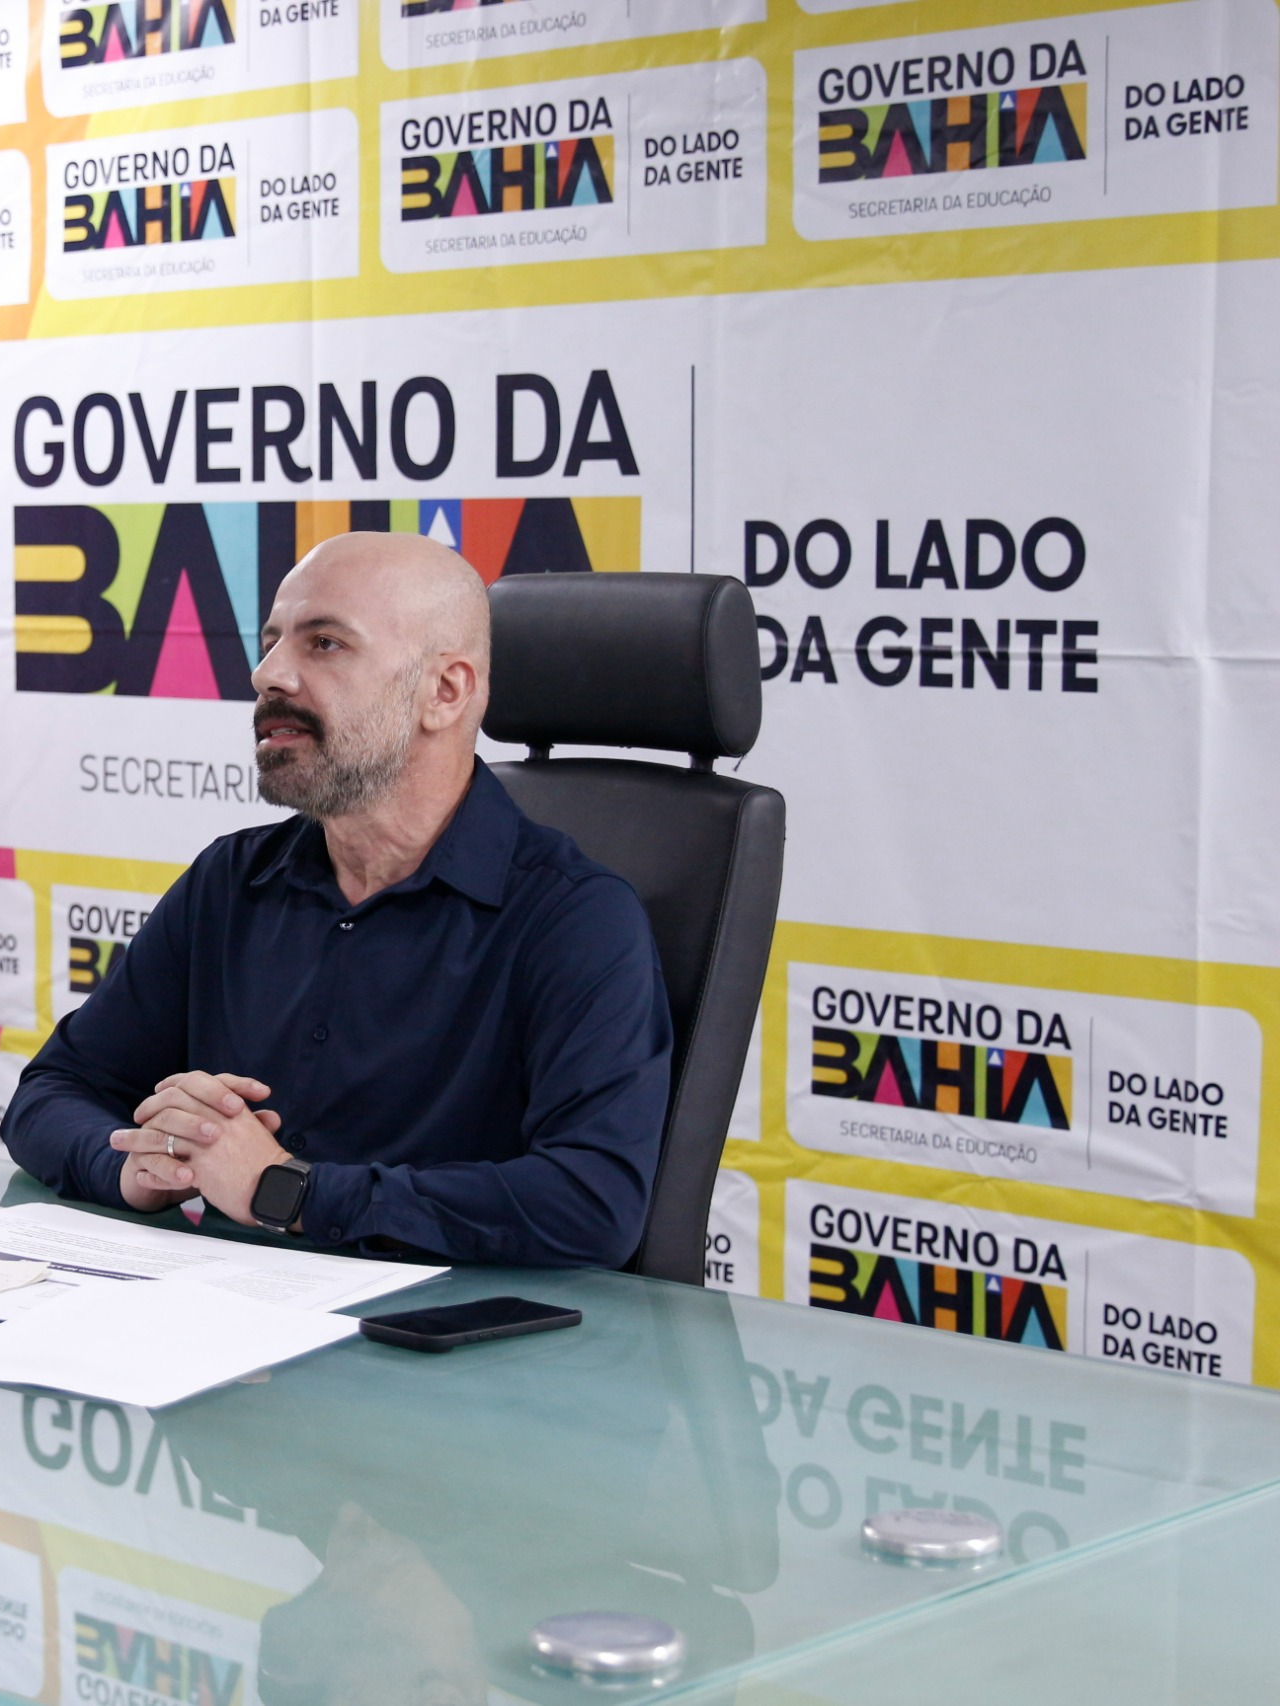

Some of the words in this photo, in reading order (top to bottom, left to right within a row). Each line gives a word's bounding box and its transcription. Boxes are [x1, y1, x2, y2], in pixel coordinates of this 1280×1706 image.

[60, 0, 236, 68] BAHIA
[260, 8, 282, 27] DA
[286, 0, 339, 22] GENTE
[425, 26, 497, 49] SECRETARIA
[500, 24, 516, 39] DA
[520, 11, 587, 36] EDUCAÇÃO
[818, 47, 1015, 104] GOVERNO
[1029, 39, 1087, 81] DA
[1125, 83, 1165, 109] DO
[1172, 74, 1245, 104] LADO
[401, 103, 557, 151] GOVERNO
[568, 97, 613, 132] DA
[644, 136, 676, 158] DO
[682, 129, 739, 155] LADO
[818, 82, 1088, 184] BAHIA
[1125, 113, 1160, 141] DA
[1166, 106, 1249, 137] GENTE
[64, 147, 190, 189] GOVERNO
[200, 142, 235, 173] DA
[260, 177, 286, 197] DO
[290, 172, 337, 195] LADO
[401, 135, 615, 222] BAHIA
[644, 165, 671, 187] DA
[676, 158, 743, 183] GENTE
[63, 176, 237, 253] BAHIA
[260, 204, 283, 223] DA
[287, 198, 340, 220] GENTE
[848, 198, 938, 219] SECRETARIA
[942, 195, 963, 211] DA
[967, 184, 1051, 209] EDUCAÇÃO
[425, 235, 497, 255] SECRETARIA
[500, 233, 516, 247] DA
[519, 225, 588, 246] EDUCAÇÃO
[13, 375, 456, 489] GOVERNO
[494, 369, 640, 479] DA
[744, 518, 852, 590] DO
[875, 516, 1086, 593] LADO
[755, 614, 838, 684] DA
[855, 614, 1099, 693] GENTE
[79, 754, 263, 804] SECRETARI
[812, 986, 1002, 1041] GOVERNO
[1016, 1008, 1072, 1050] DA
[811, 1025, 1073, 1131] BAHIA
[1109, 1070, 1147, 1096] DO
[1154, 1076, 1224, 1106] LADO
[840, 1120, 928, 1147] SECRETARIA
[932, 1133, 952, 1151] DA
[956, 1137, 1038, 1164] EDUCAÇÃO
[1108, 1100, 1142, 1127] DA
[1147, 1106, 1228, 1139] GENTE
[810, 1204, 999, 1268] GOVERNO
[1013, 1237, 1068, 1281] DA
[809, 1243, 1068, 1352] BAHIA
[1104, 1303, 1142, 1330] DO
[1149, 1311, 1217, 1345] LADO
[1103, 1334, 1135, 1361] DA
[1142, 1342, 1222, 1377] GENTE
